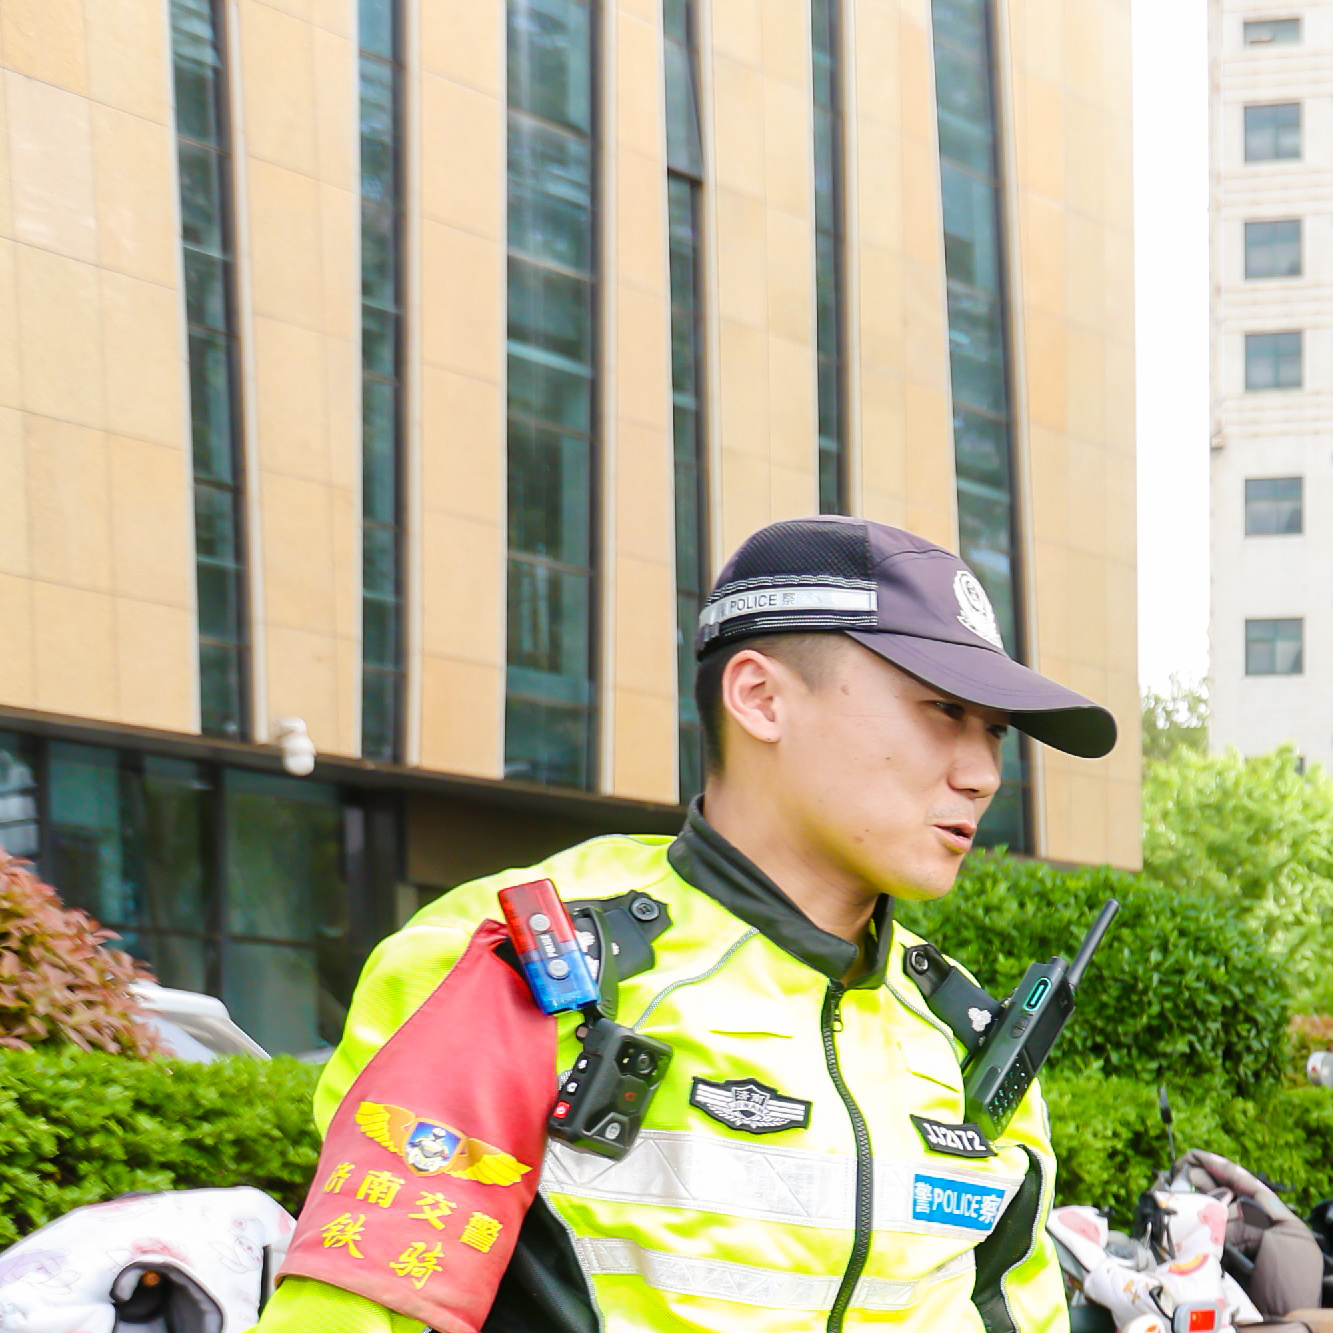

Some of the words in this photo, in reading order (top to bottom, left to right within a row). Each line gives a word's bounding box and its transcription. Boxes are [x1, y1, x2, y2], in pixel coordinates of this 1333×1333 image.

[730, 593, 777, 613] POLICE
[323, 1161, 504, 1254] 济南交警
[319, 1211, 446, 1290] 铁骑
